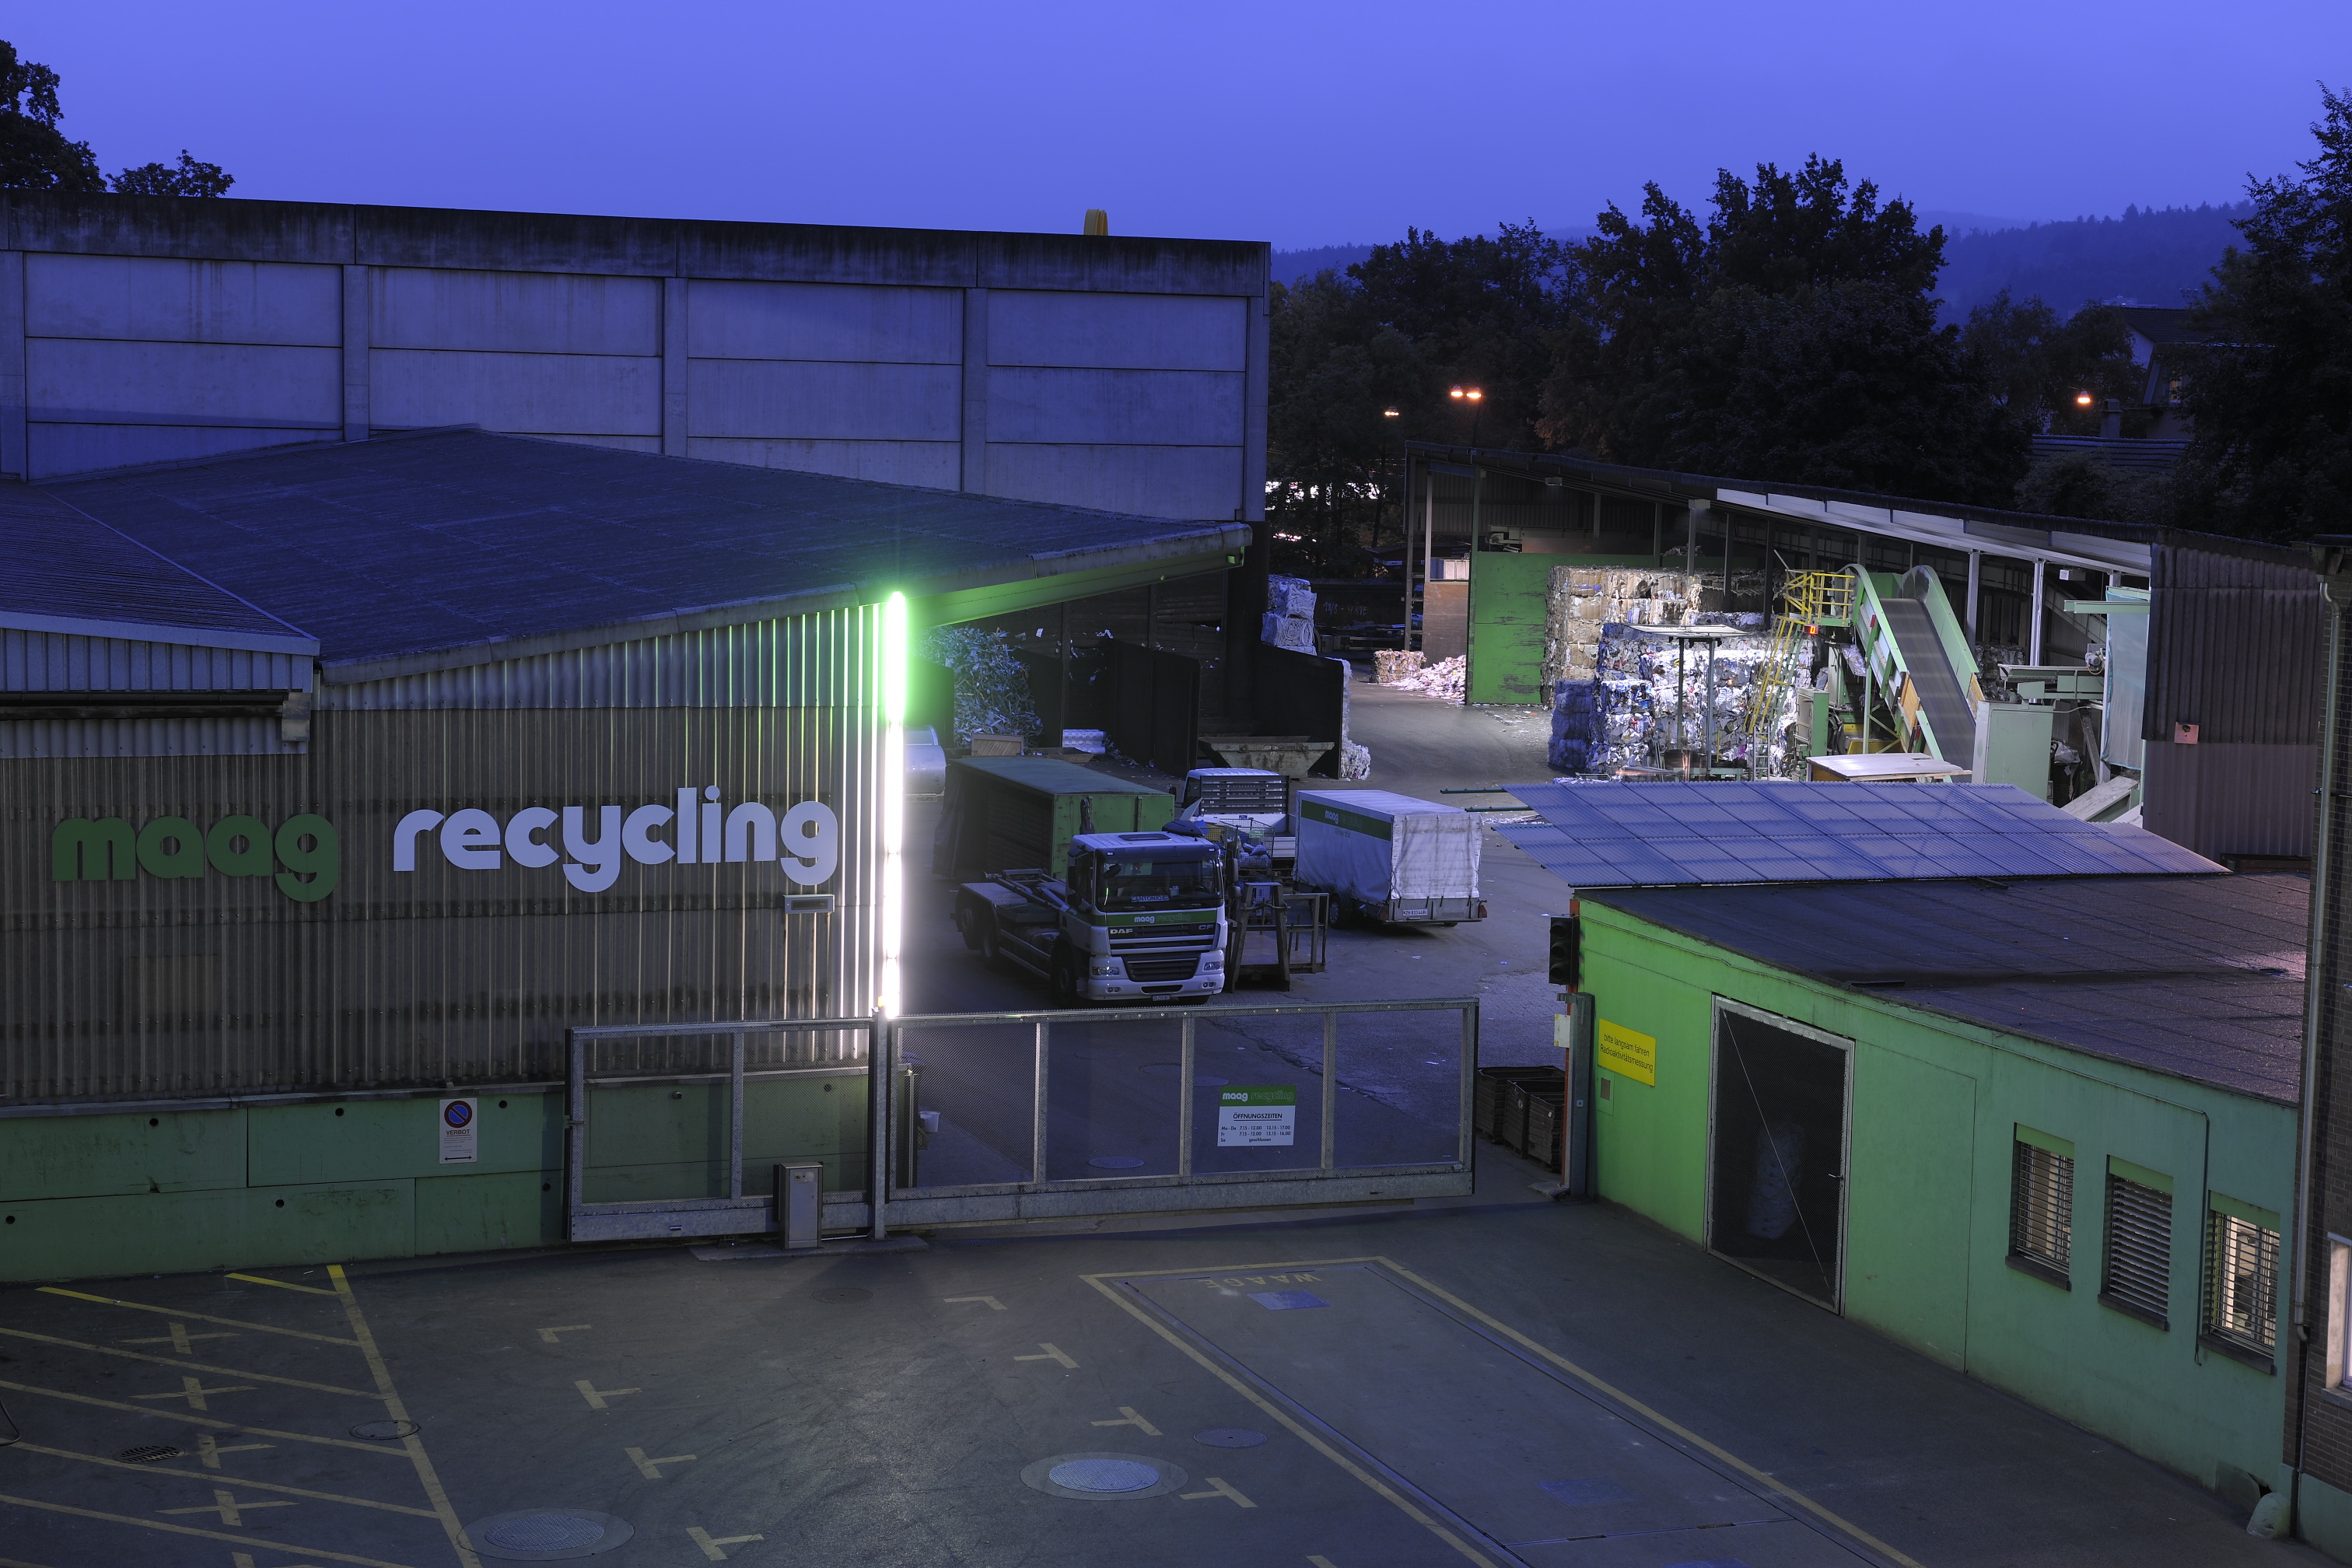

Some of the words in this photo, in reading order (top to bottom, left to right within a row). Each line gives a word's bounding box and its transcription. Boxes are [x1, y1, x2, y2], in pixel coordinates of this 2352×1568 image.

[51, 813, 339, 902] maag
[394, 786, 838, 892] recycling
[1156, 913, 1192, 922] recycling
[1604, 1033, 1613, 1044] bitte
[1614, 1037, 1633, 1052] langsam
[1635, 1044, 1650, 1057] fahren
[1600, 1043, 1654, 1073] Radioaktivitätsmessung
[1222, 1092, 1248, 1102] maag
[1251, 1090, 1294, 1102] recycling
[1198, 1273, 1323, 1288] WAAGE
